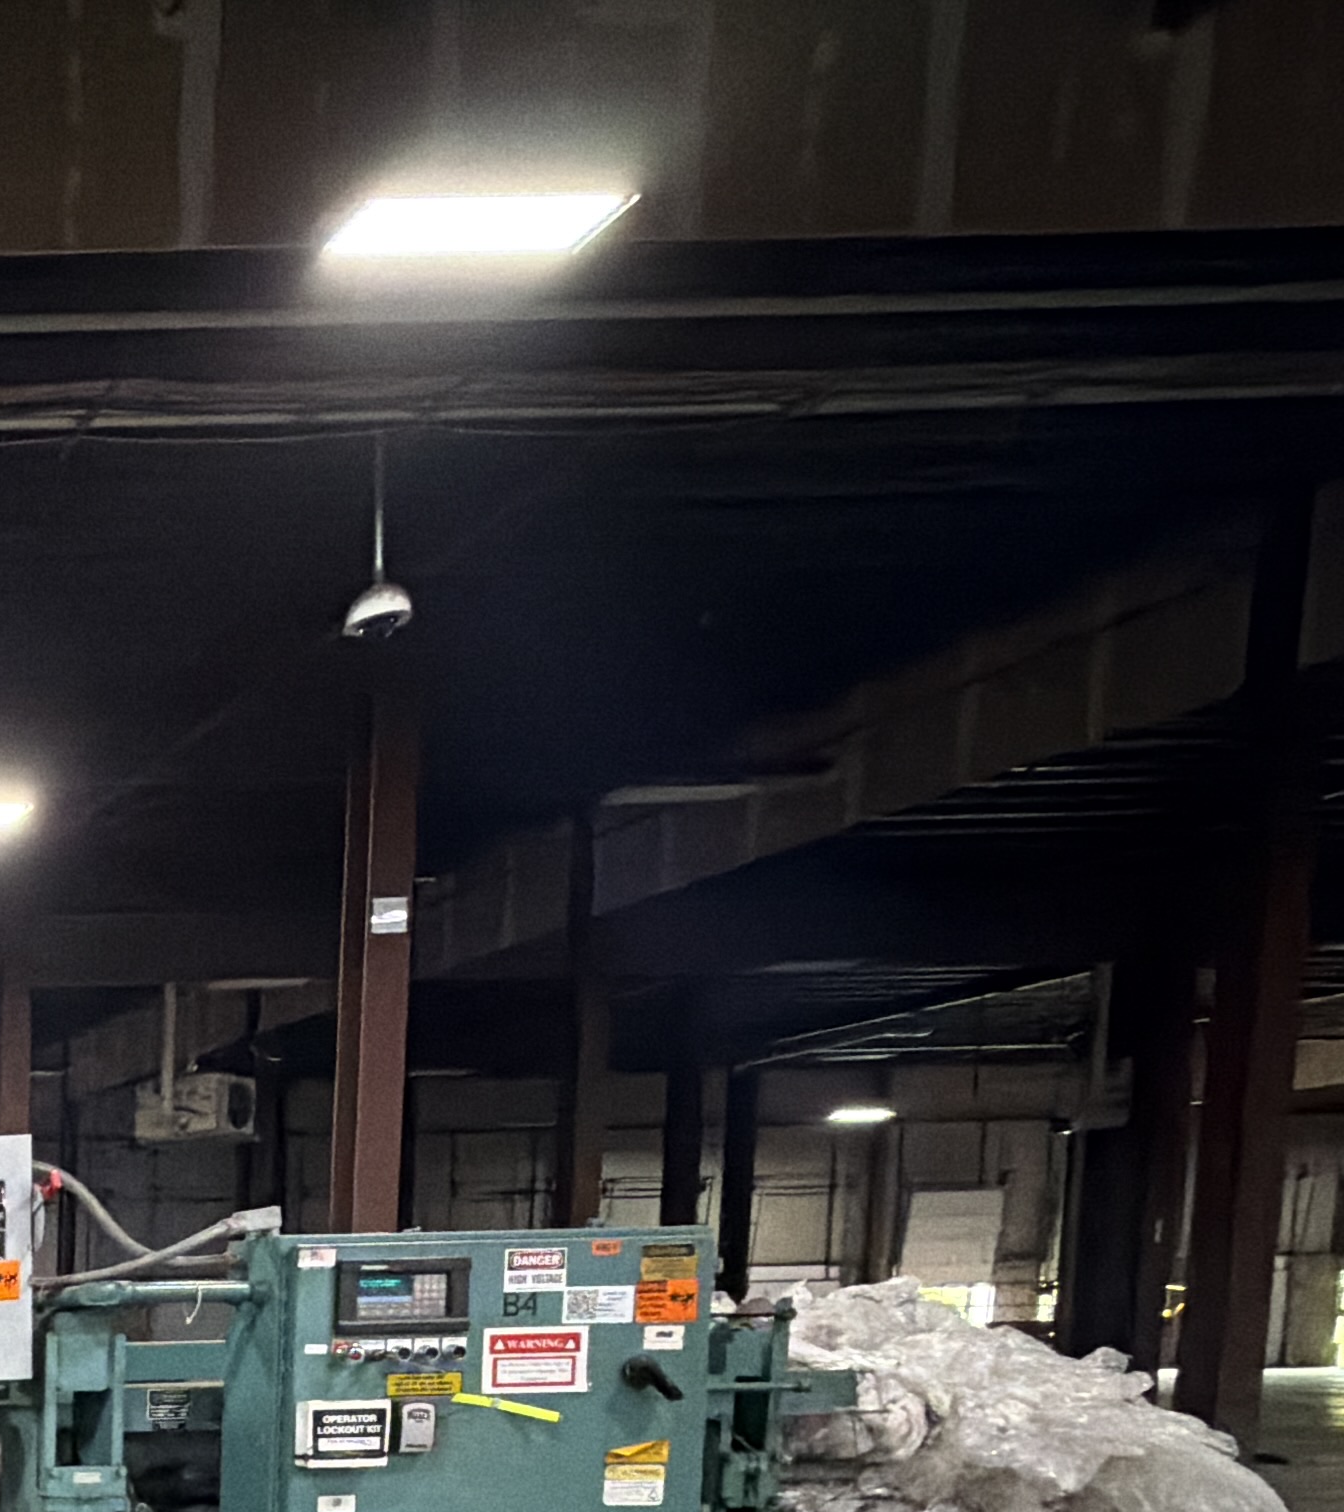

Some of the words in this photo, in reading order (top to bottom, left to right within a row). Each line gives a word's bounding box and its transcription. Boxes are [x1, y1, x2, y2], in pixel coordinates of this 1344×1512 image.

[513, 1254, 561, 1267] DANGER
[503, 1292, 537, 1317] B4
[506, 1338, 564, 1349] WARNING
[322, 1414, 377, 1423] OPERATOR
[316, 1424, 365, 1435] LOCKOUT
[366, 1424, 383, 1433] KIT
